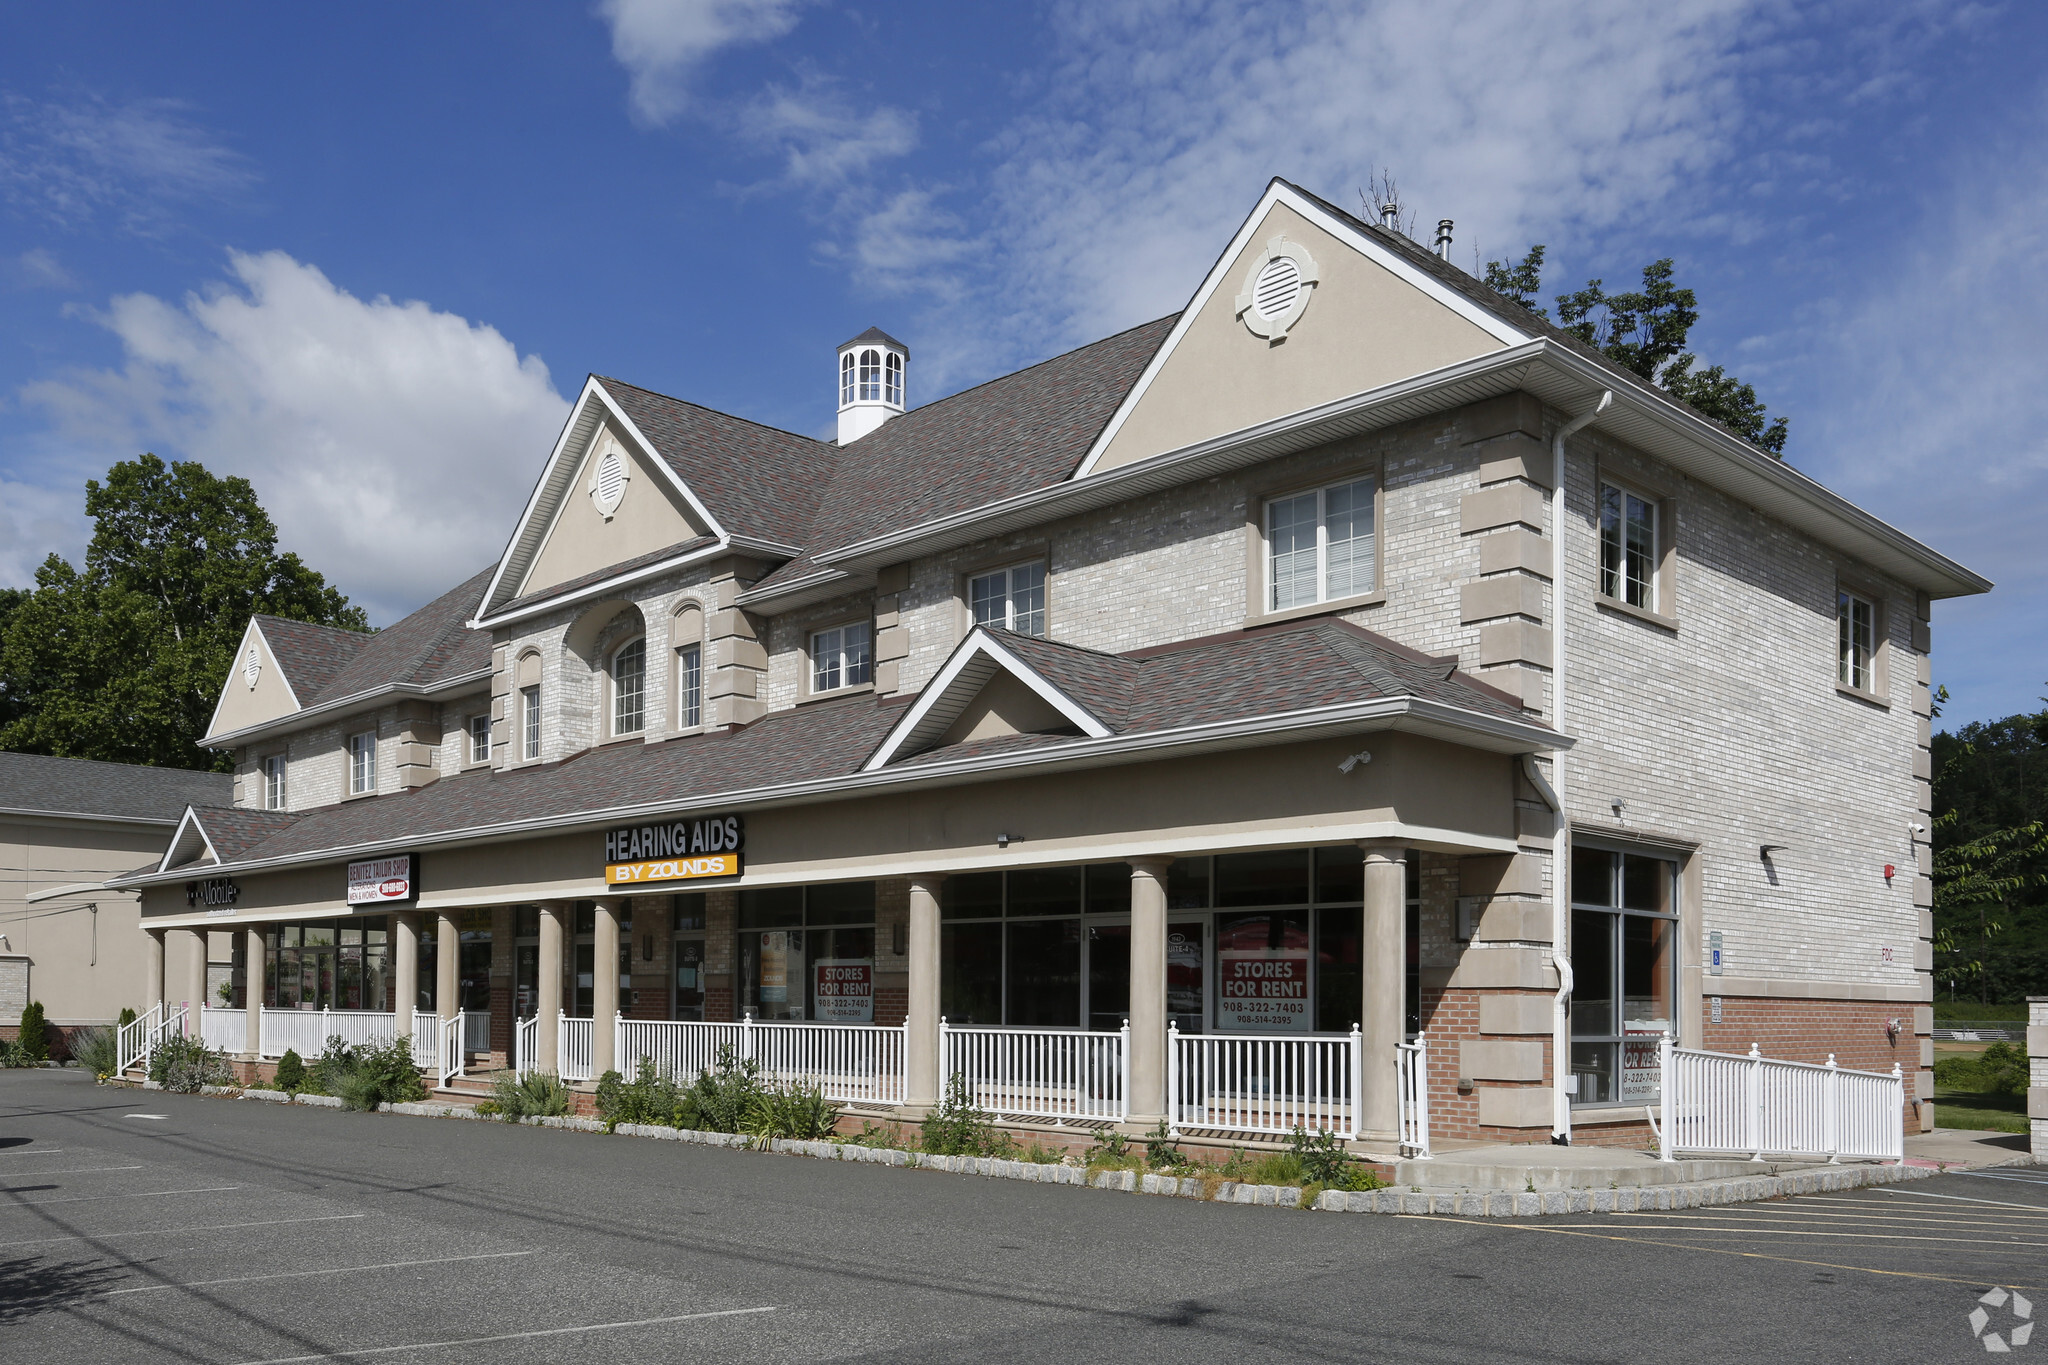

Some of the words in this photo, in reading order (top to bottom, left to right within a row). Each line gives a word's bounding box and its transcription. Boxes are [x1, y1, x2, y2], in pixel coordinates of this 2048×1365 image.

[605, 823, 686, 861] HEARING
[690, 816, 738, 852] AIDS
[349, 863, 372, 881] BENITEZ
[373, 860, 392, 879] TAILOR
[393, 858, 409, 876] SHOP
[615, 865, 644, 881] BY
[648, 857, 725, 878] ZOUNDS
[362, 890, 378, 900] WOMEN
[1881, 947, 1893, 961] FDC
[825, 967, 864, 981] STORES
[1234, 961, 1293, 978] STORES
[820, 982, 840, 995] FOR
[843, 982, 869, 995] RENT
[1225, 980, 1257, 996] FOR
[1261, 981, 1303, 997] RENT
[818, 999, 869, 1008] 908-322-7403
[1223, 1001, 1304, 1014] 908-322-7403
[1237, 1015, 1292, 1025] 908-514-2395
[1624, 1051, 1640, 1068] OR
[1640, 1051, 1661, 1068] REN
[1624, 1072, 1661, 1083] 8-322-7403
